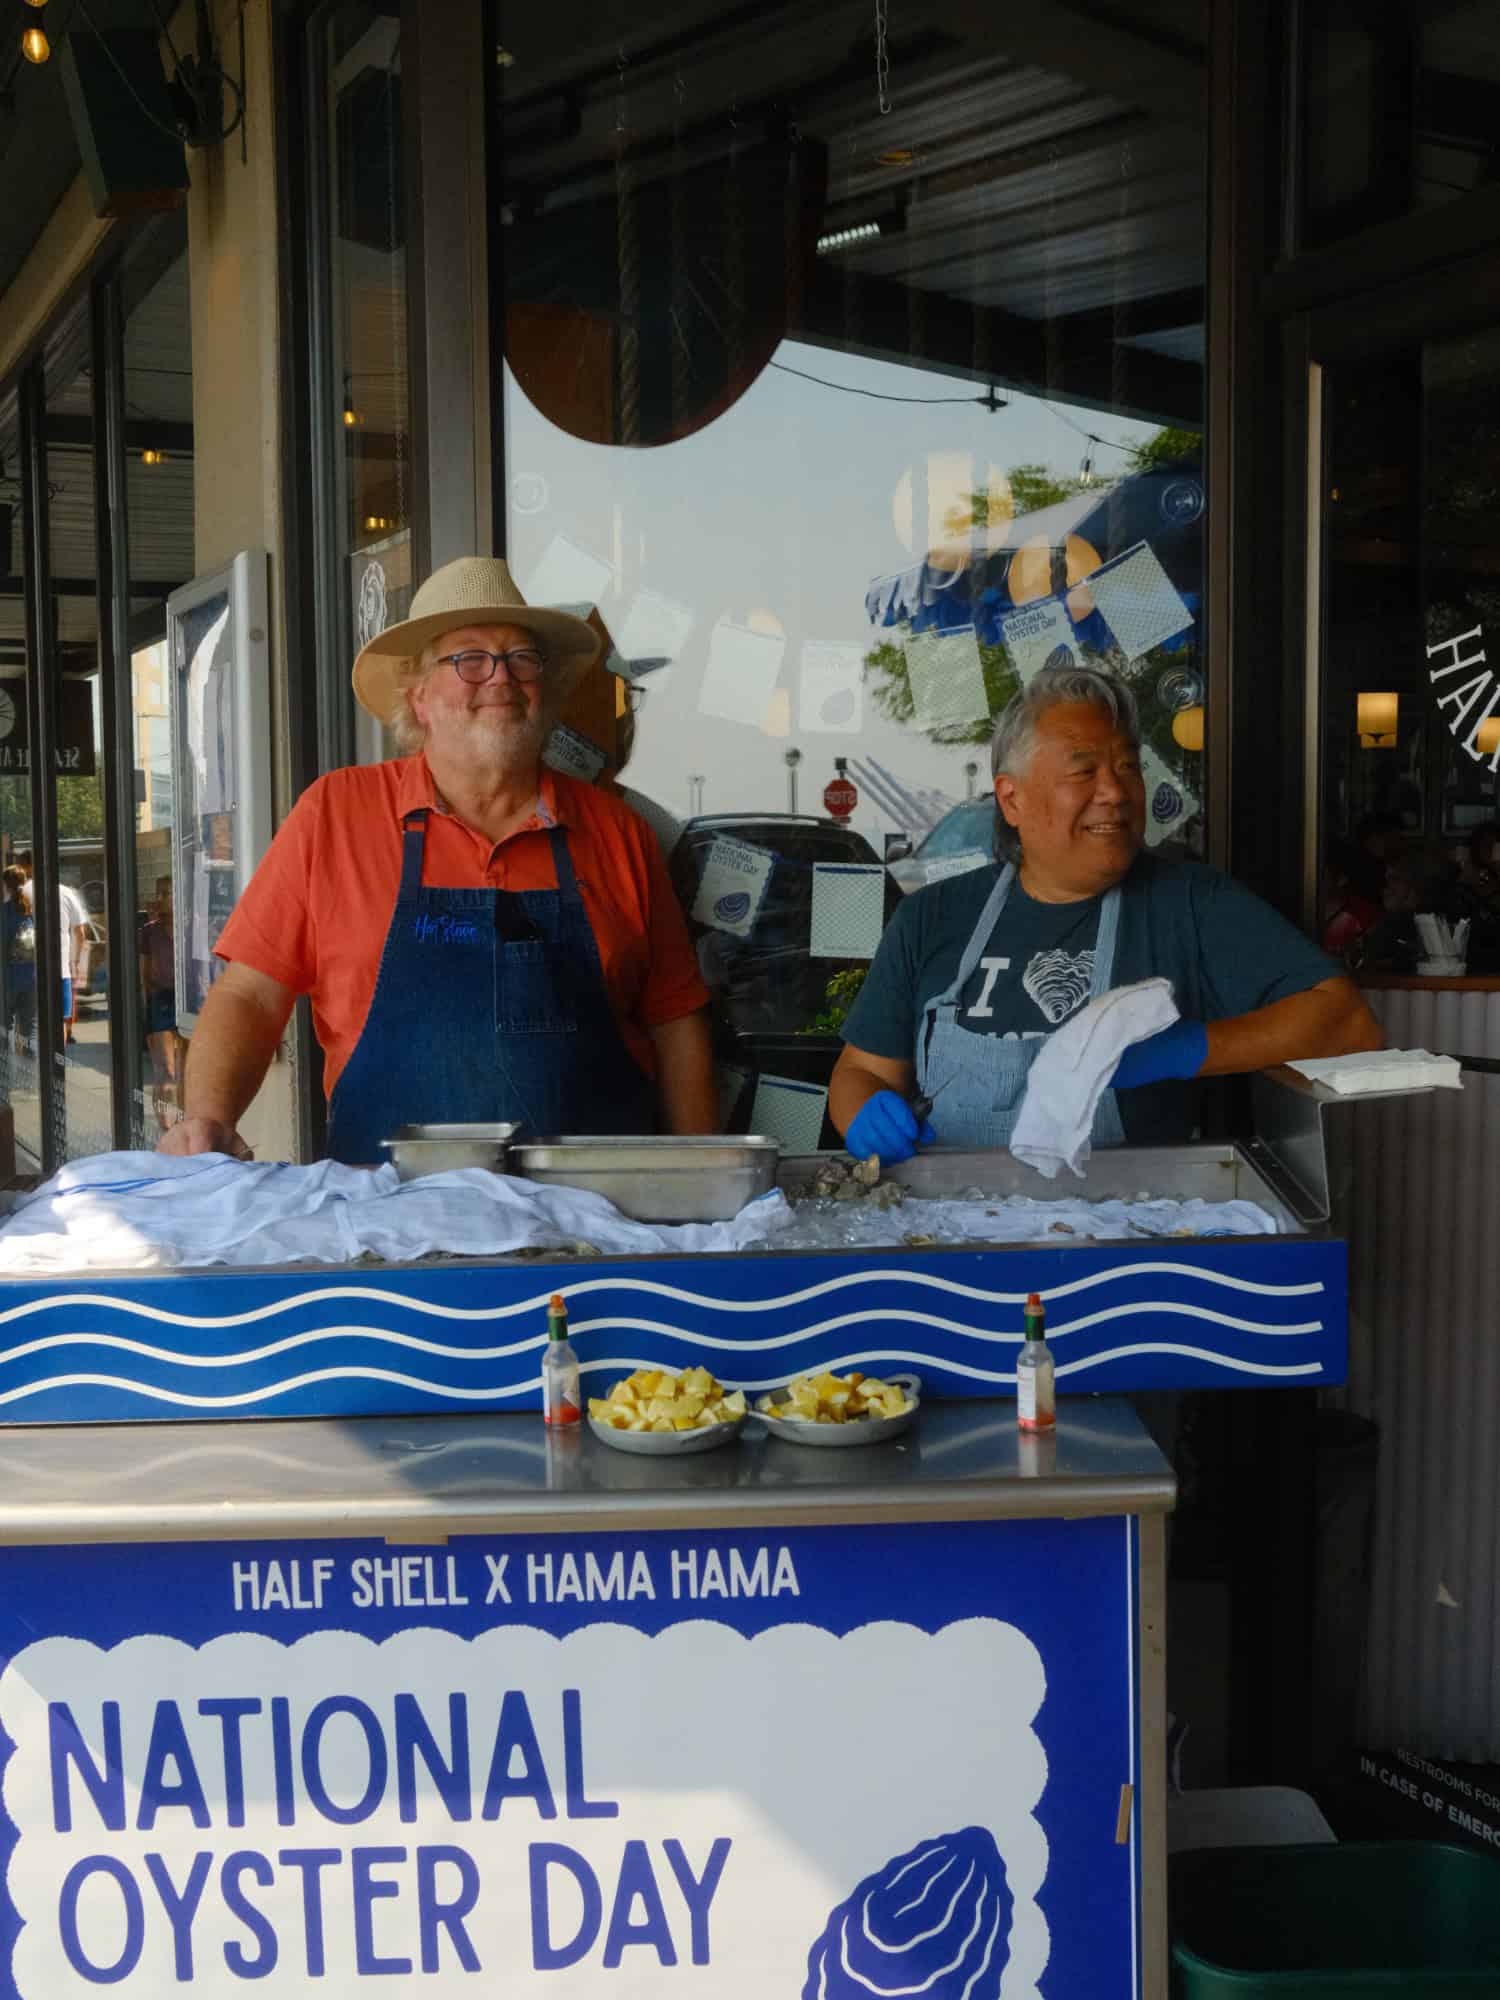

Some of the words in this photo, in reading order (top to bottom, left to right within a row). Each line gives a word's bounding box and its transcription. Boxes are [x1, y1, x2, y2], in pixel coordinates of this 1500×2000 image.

[1426, 624, 1500, 773] HAL
[233, 1559, 334, 1610] HALF
[352, 1556, 468, 1607] SHELL
[485, 1554, 512, 1604] X
[527, 1551, 656, 1603] HAMA
[671, 1547, 800, 1599] HAMA
[48, 1689, 619, 1832] NATIONAL
[1360, 1754, 1377, 1777] IN
[1379, 1766, 1419, 1801] CASE
[1421, 1790, 1445, 1815] OF
[1396, 1745, 1473, 1797] RESTROOMS
[58, 1845, 481, 1984] OYSTER
[528, 1838, 732, 1970] DAY
